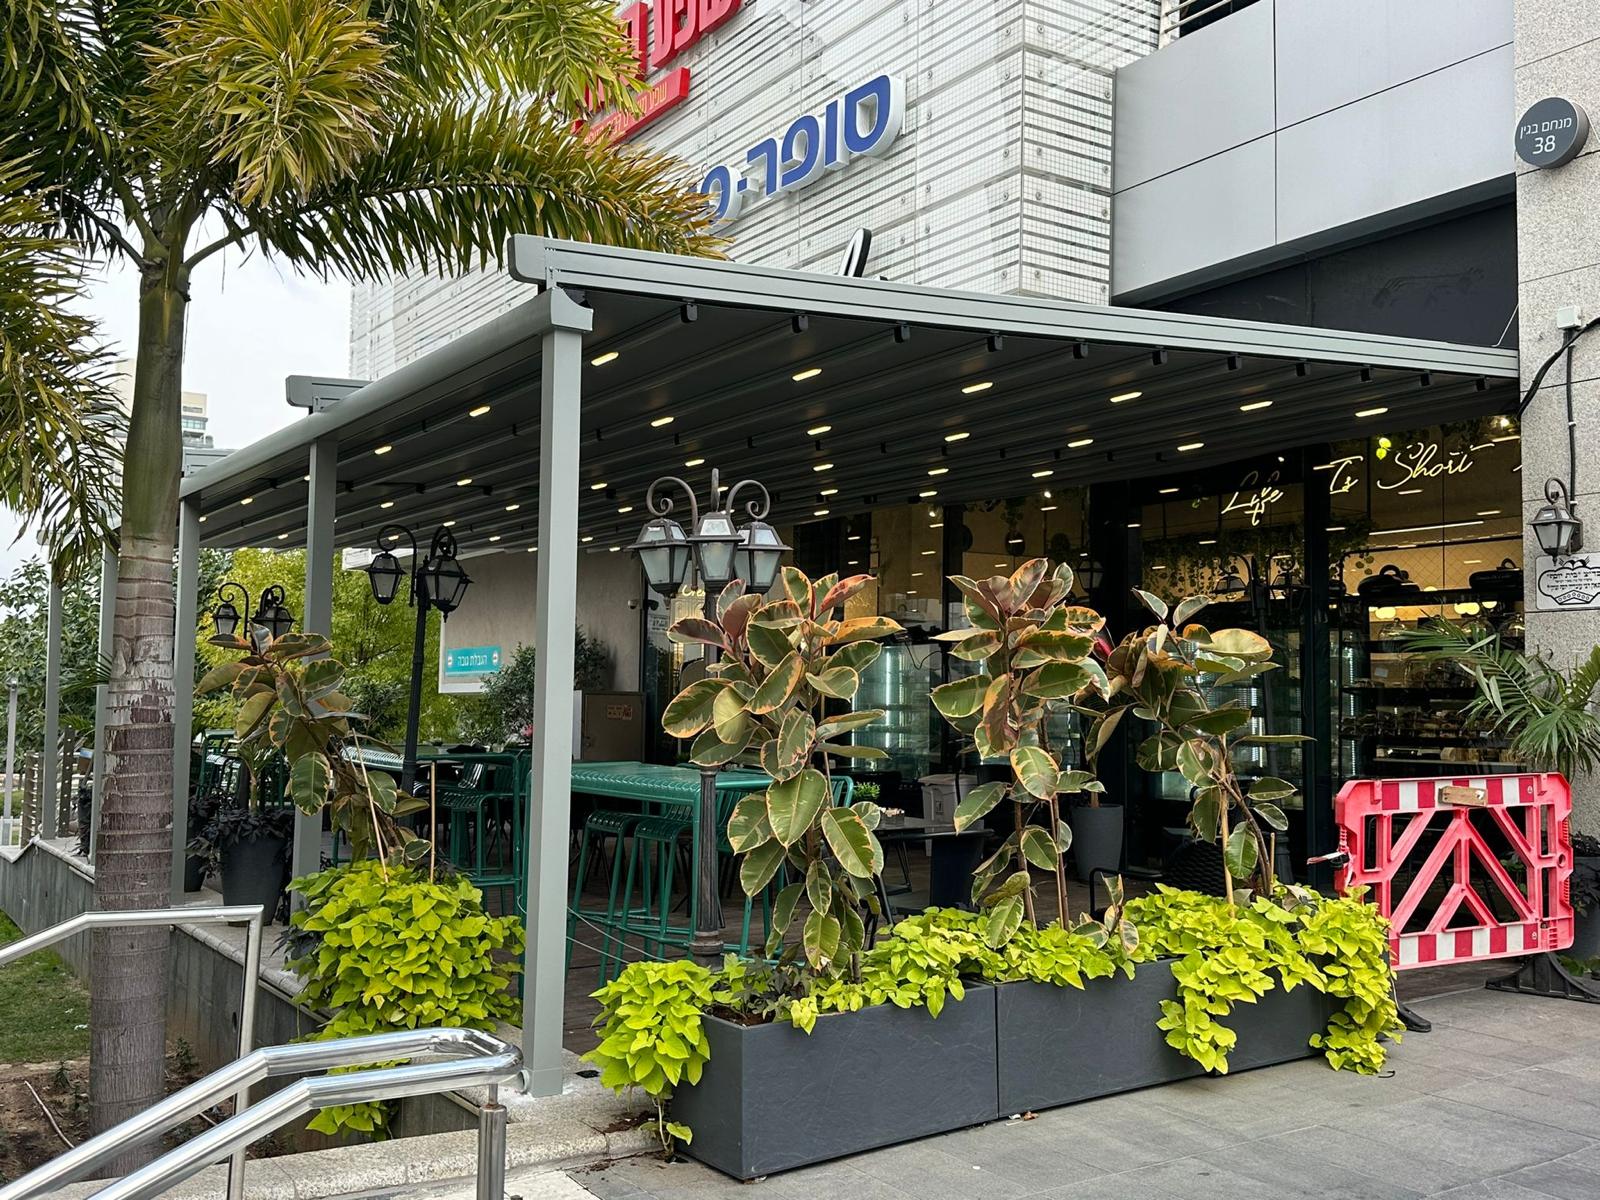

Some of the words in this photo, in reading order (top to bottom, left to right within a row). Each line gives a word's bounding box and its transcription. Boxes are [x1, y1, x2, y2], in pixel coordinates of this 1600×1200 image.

[1519, 124, 1539, 140] בגין
[1541, 117, 1572, 133] מנחם
[1532, 134, 1556, 155] 38
[1376, 442, 1496, 490] Short
